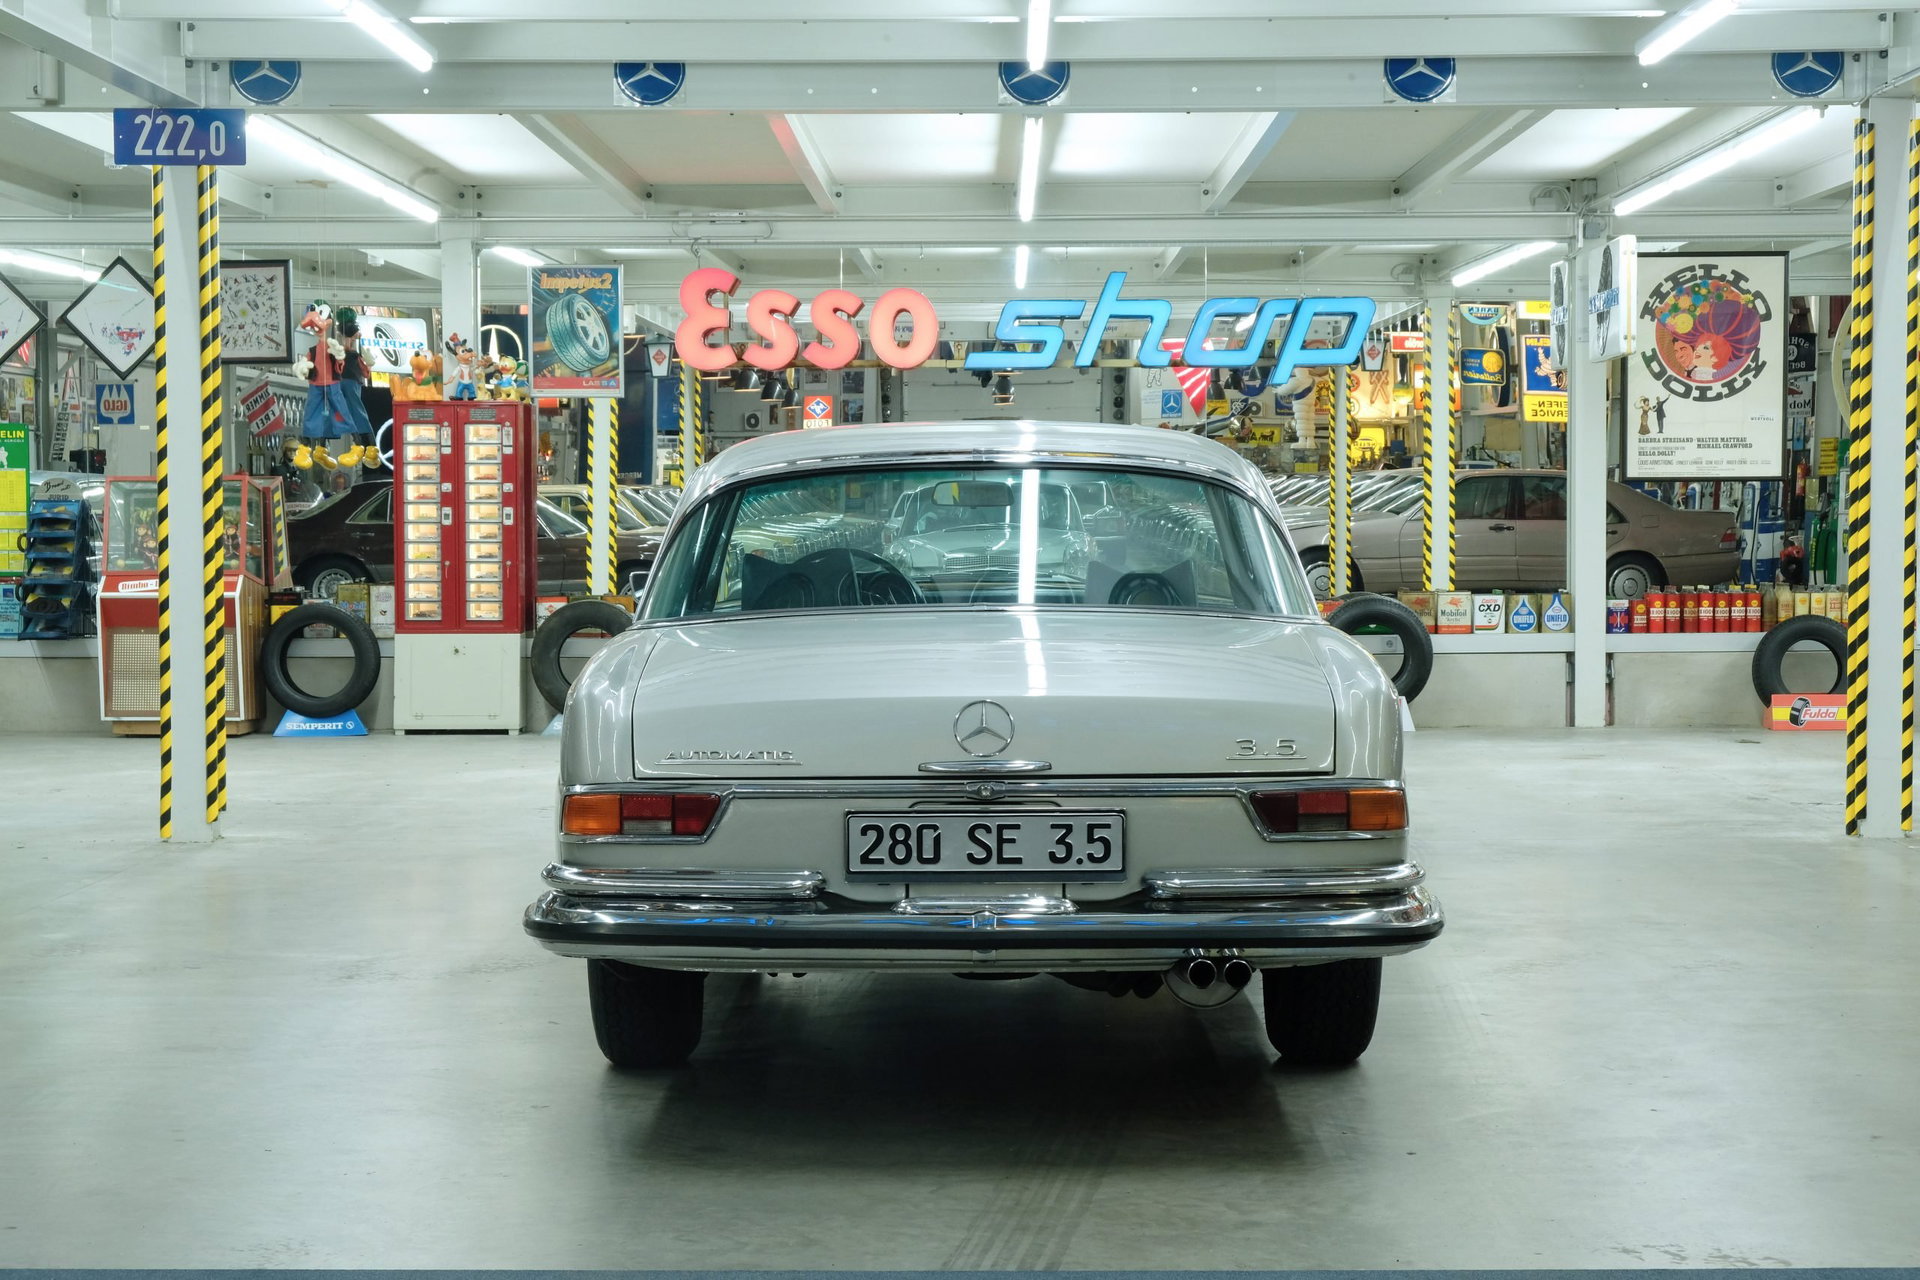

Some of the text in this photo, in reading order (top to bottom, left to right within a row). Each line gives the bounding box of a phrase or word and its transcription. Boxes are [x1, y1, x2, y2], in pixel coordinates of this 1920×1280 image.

[134, 114, 226, 161] 222,0
[1640, 264, 1772, 322] HELLO
[1641, 347, 1767, 402] DOLLY
[1440, 608, 1467, 617] Mobiloil
[1478, 604, 1501, 612] CXD
[1513, 615, 1534, 623] UNIFLO
[1546, 614, 1567, 622] UNIFLO
[1803, 709, 1836, 719] Fulda
[286, 722, 343, 730] SEMPERIT
[1235, 738, 1297, 756] 3.5
[665, 750, 794, 760] AUTOMATIC
[860, 823, 1112, 865] 280 SE 3.5
